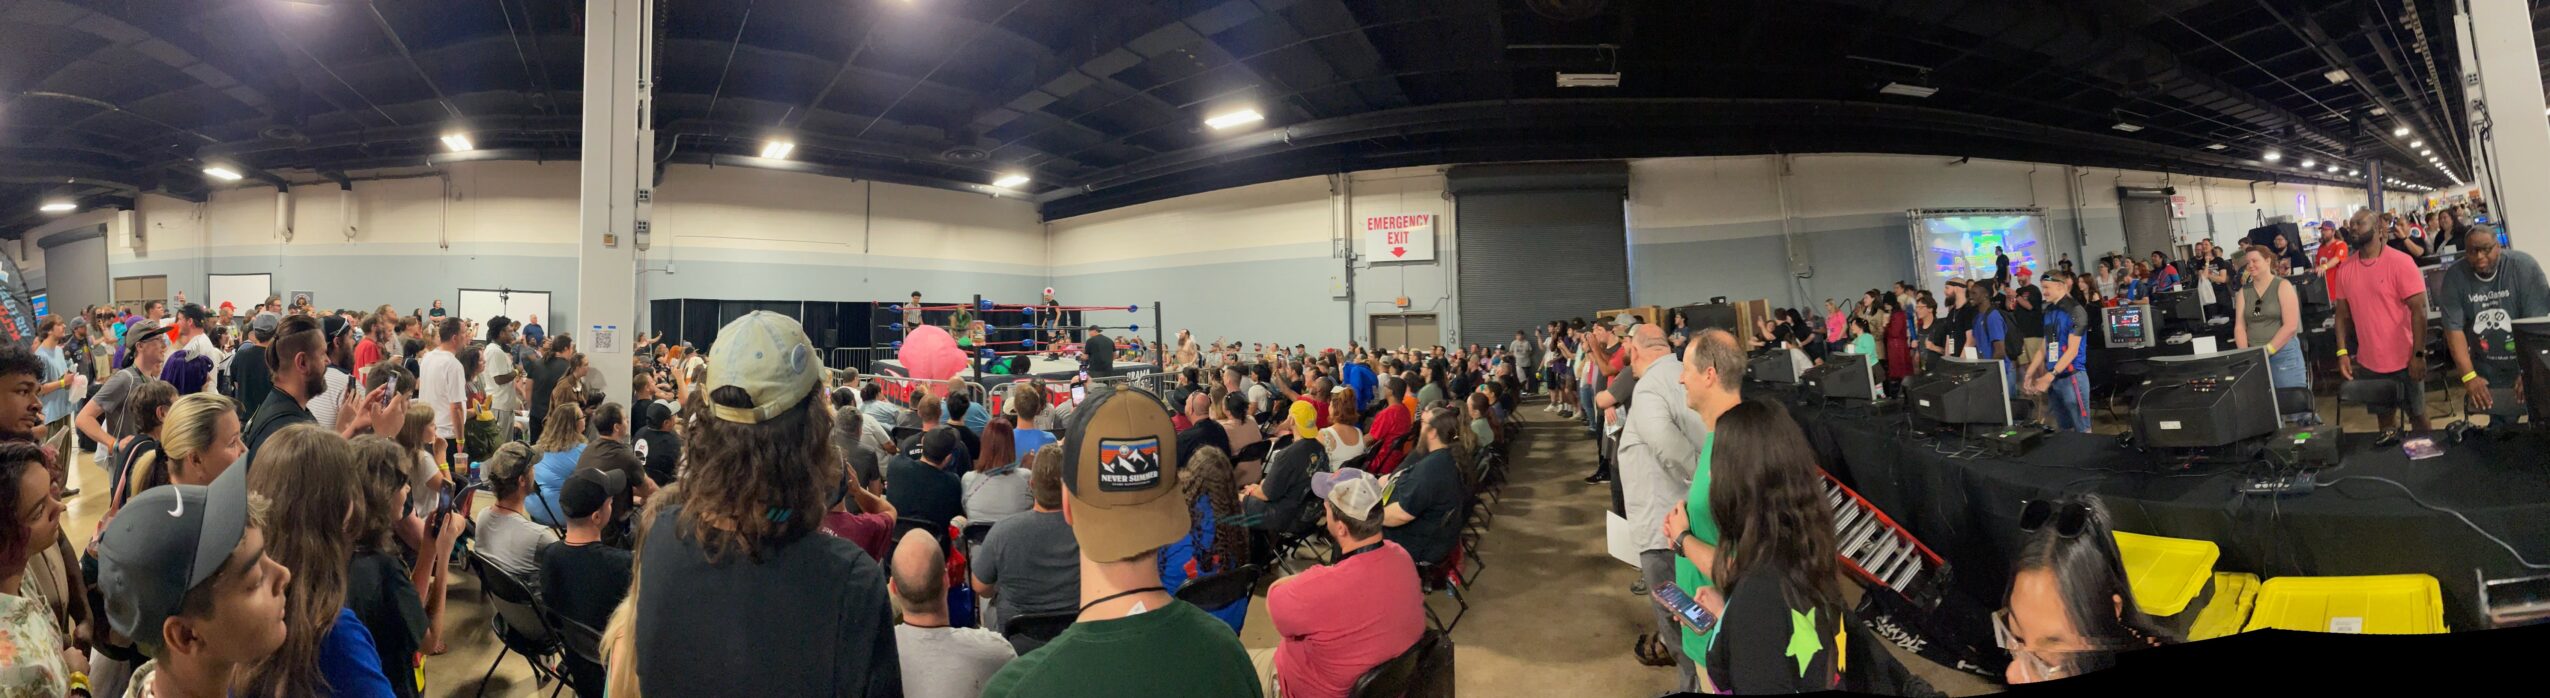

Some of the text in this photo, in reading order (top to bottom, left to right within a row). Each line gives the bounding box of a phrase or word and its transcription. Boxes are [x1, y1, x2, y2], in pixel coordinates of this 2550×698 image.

[1367, 214, 1429, 230] EMERGENCY
[1387, 231, 1409, 244] EXIT
[2468, 293, 2488, 302] Vdeo
[1101, 474, 1128, 482] NEVER
